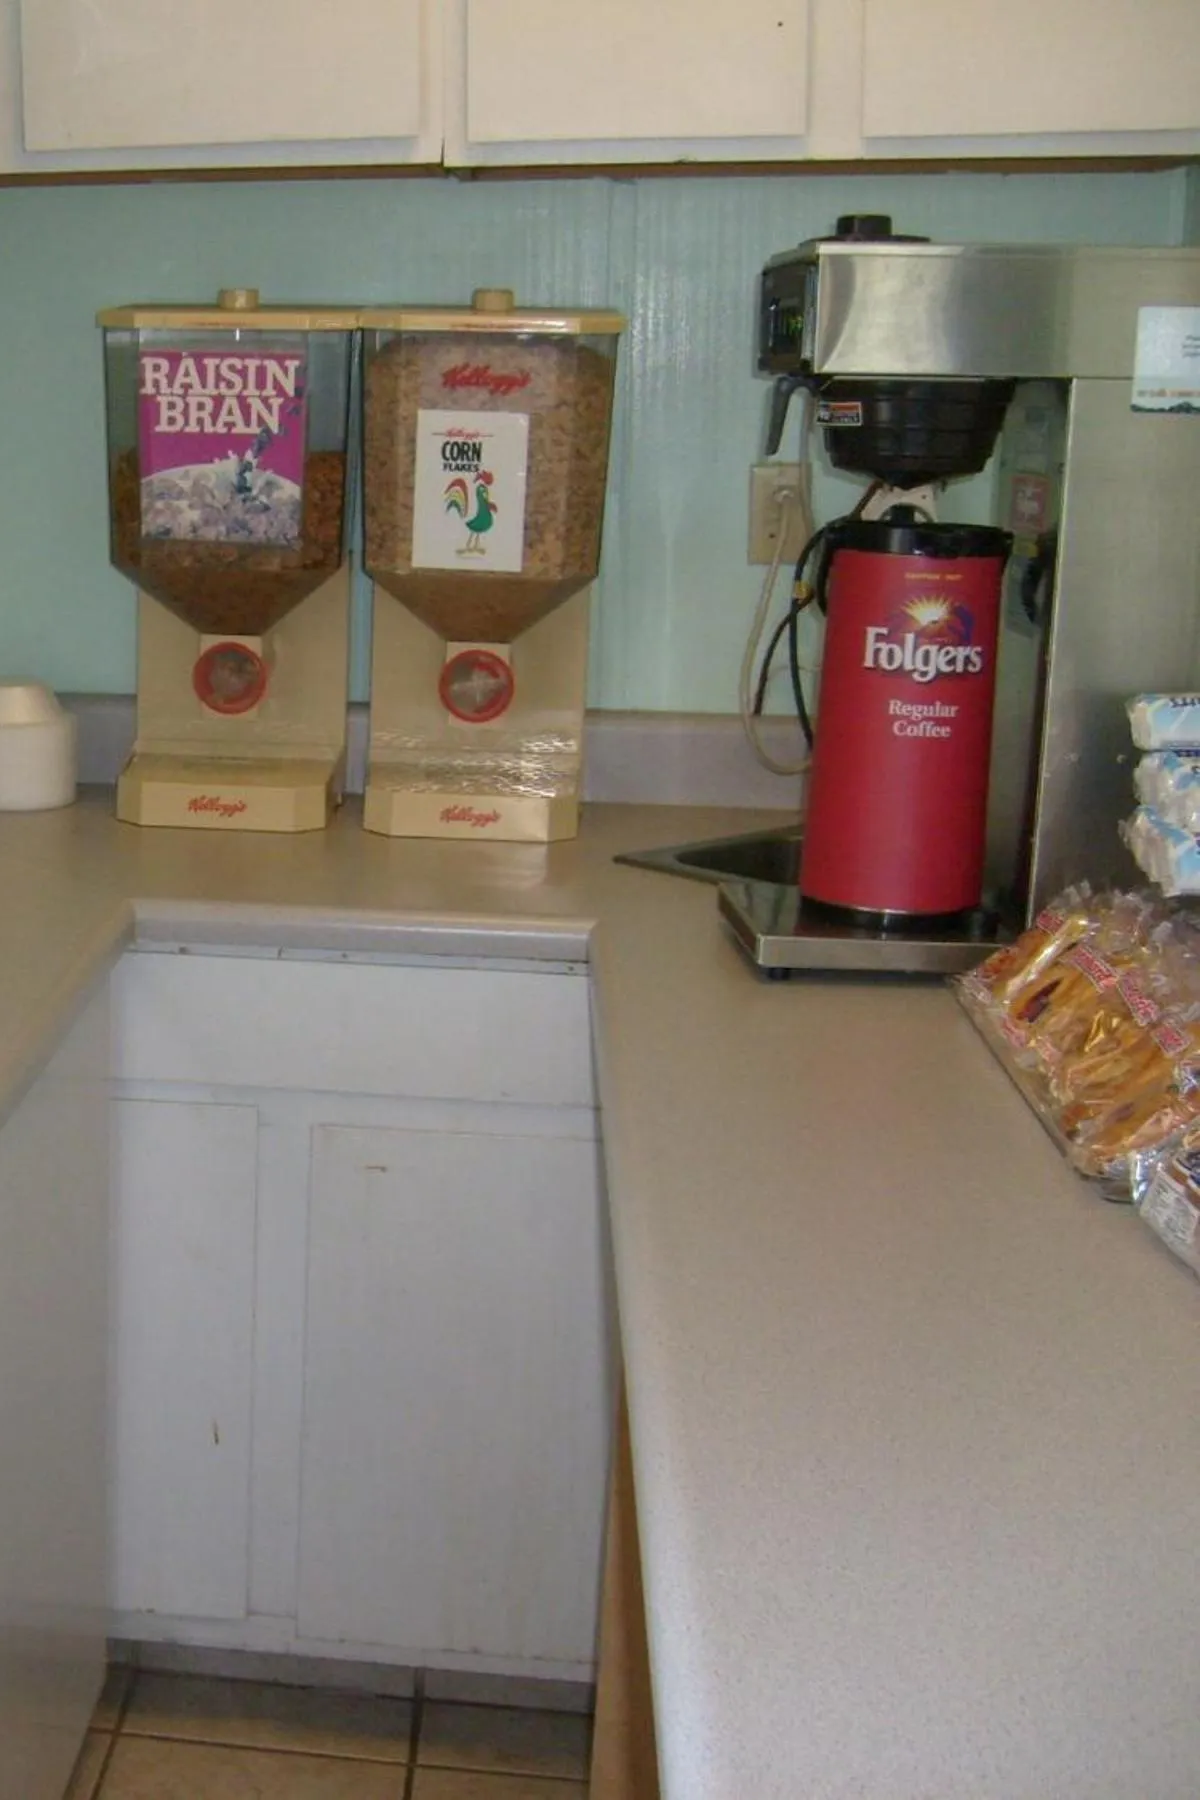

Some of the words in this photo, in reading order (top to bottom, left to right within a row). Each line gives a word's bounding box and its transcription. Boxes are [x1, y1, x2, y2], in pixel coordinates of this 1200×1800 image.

[140, 356, 300, 398] RAISIN
[155, 395, 284, 435] BRAN
[441, 441, 483, 463] CORN
[442, 462, 480, 473] FLAKES
[863, 626, 983, 683] Folgers
[888, 699, 959, 720] Regular
[892, 720, 952, 738] Coffee
